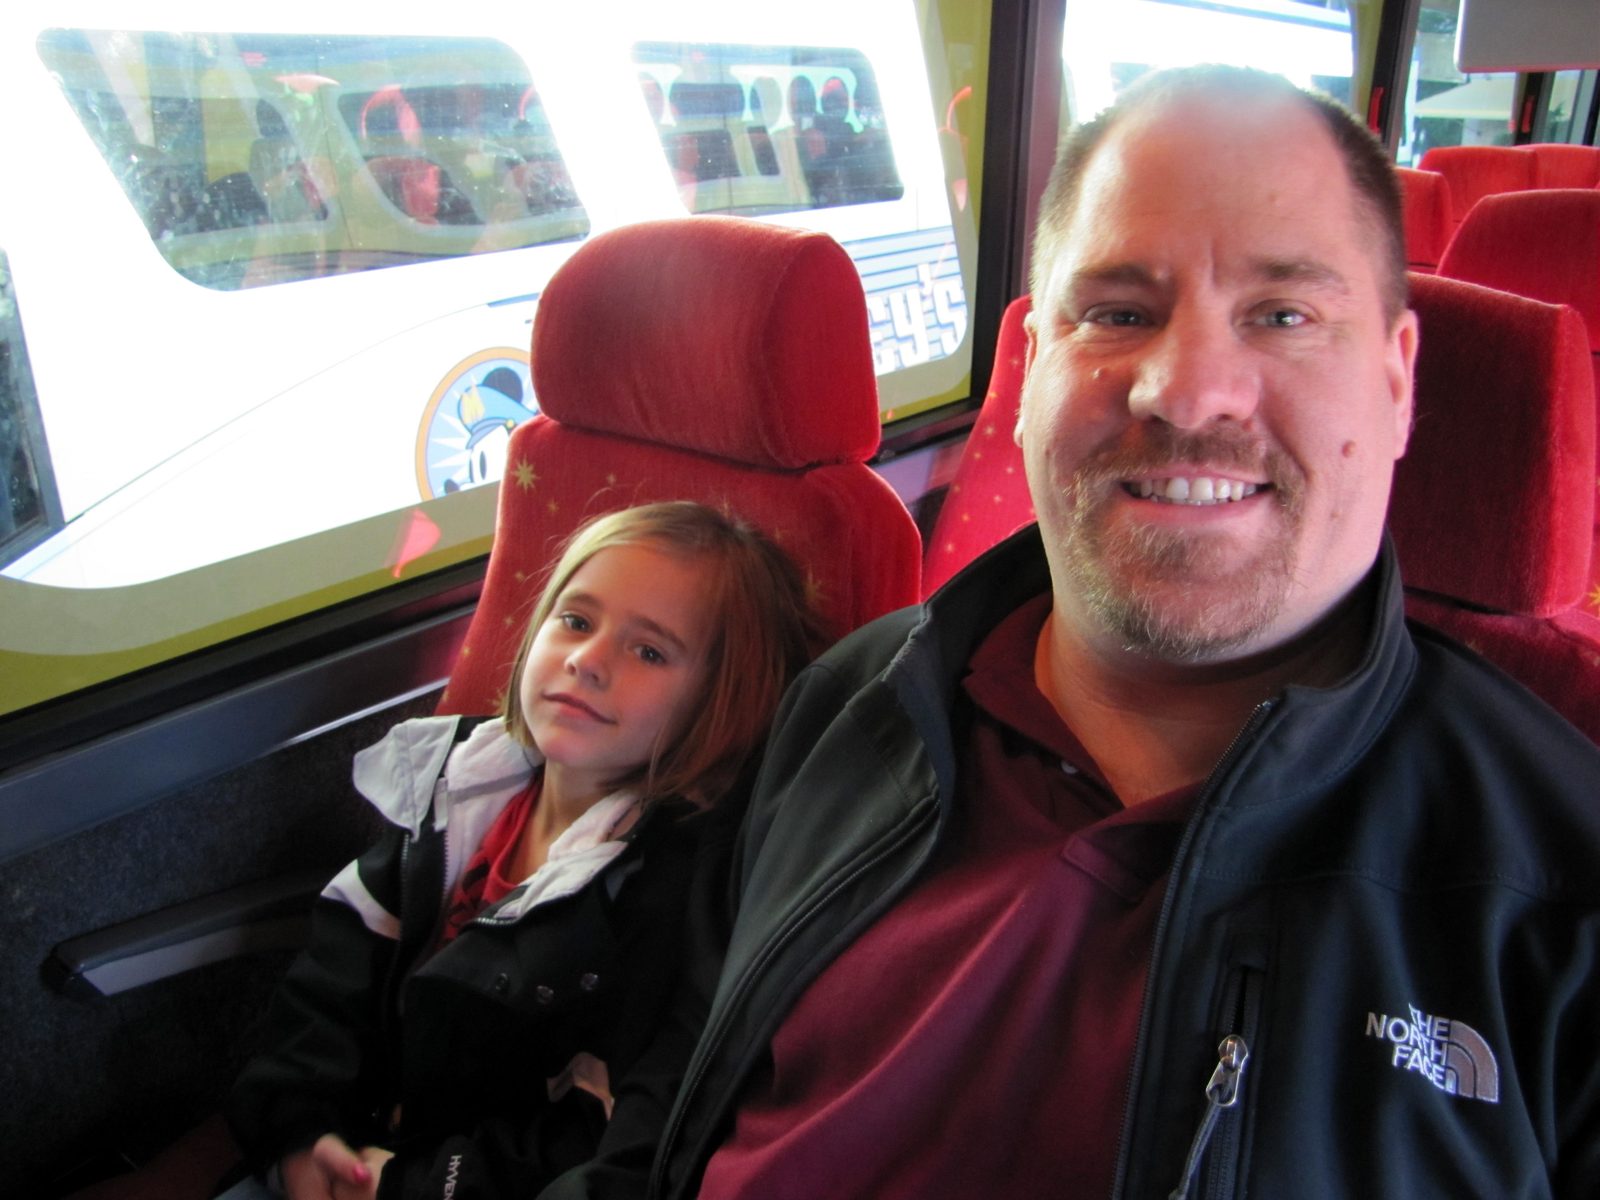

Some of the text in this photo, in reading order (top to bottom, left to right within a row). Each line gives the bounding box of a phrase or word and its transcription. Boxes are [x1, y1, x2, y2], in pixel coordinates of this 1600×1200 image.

[1365, 1011, 1448, 1066] NORTH
[1408, 1002, 1450, 1041] THE
[1391, 1043, 1446, 1090] FACE
